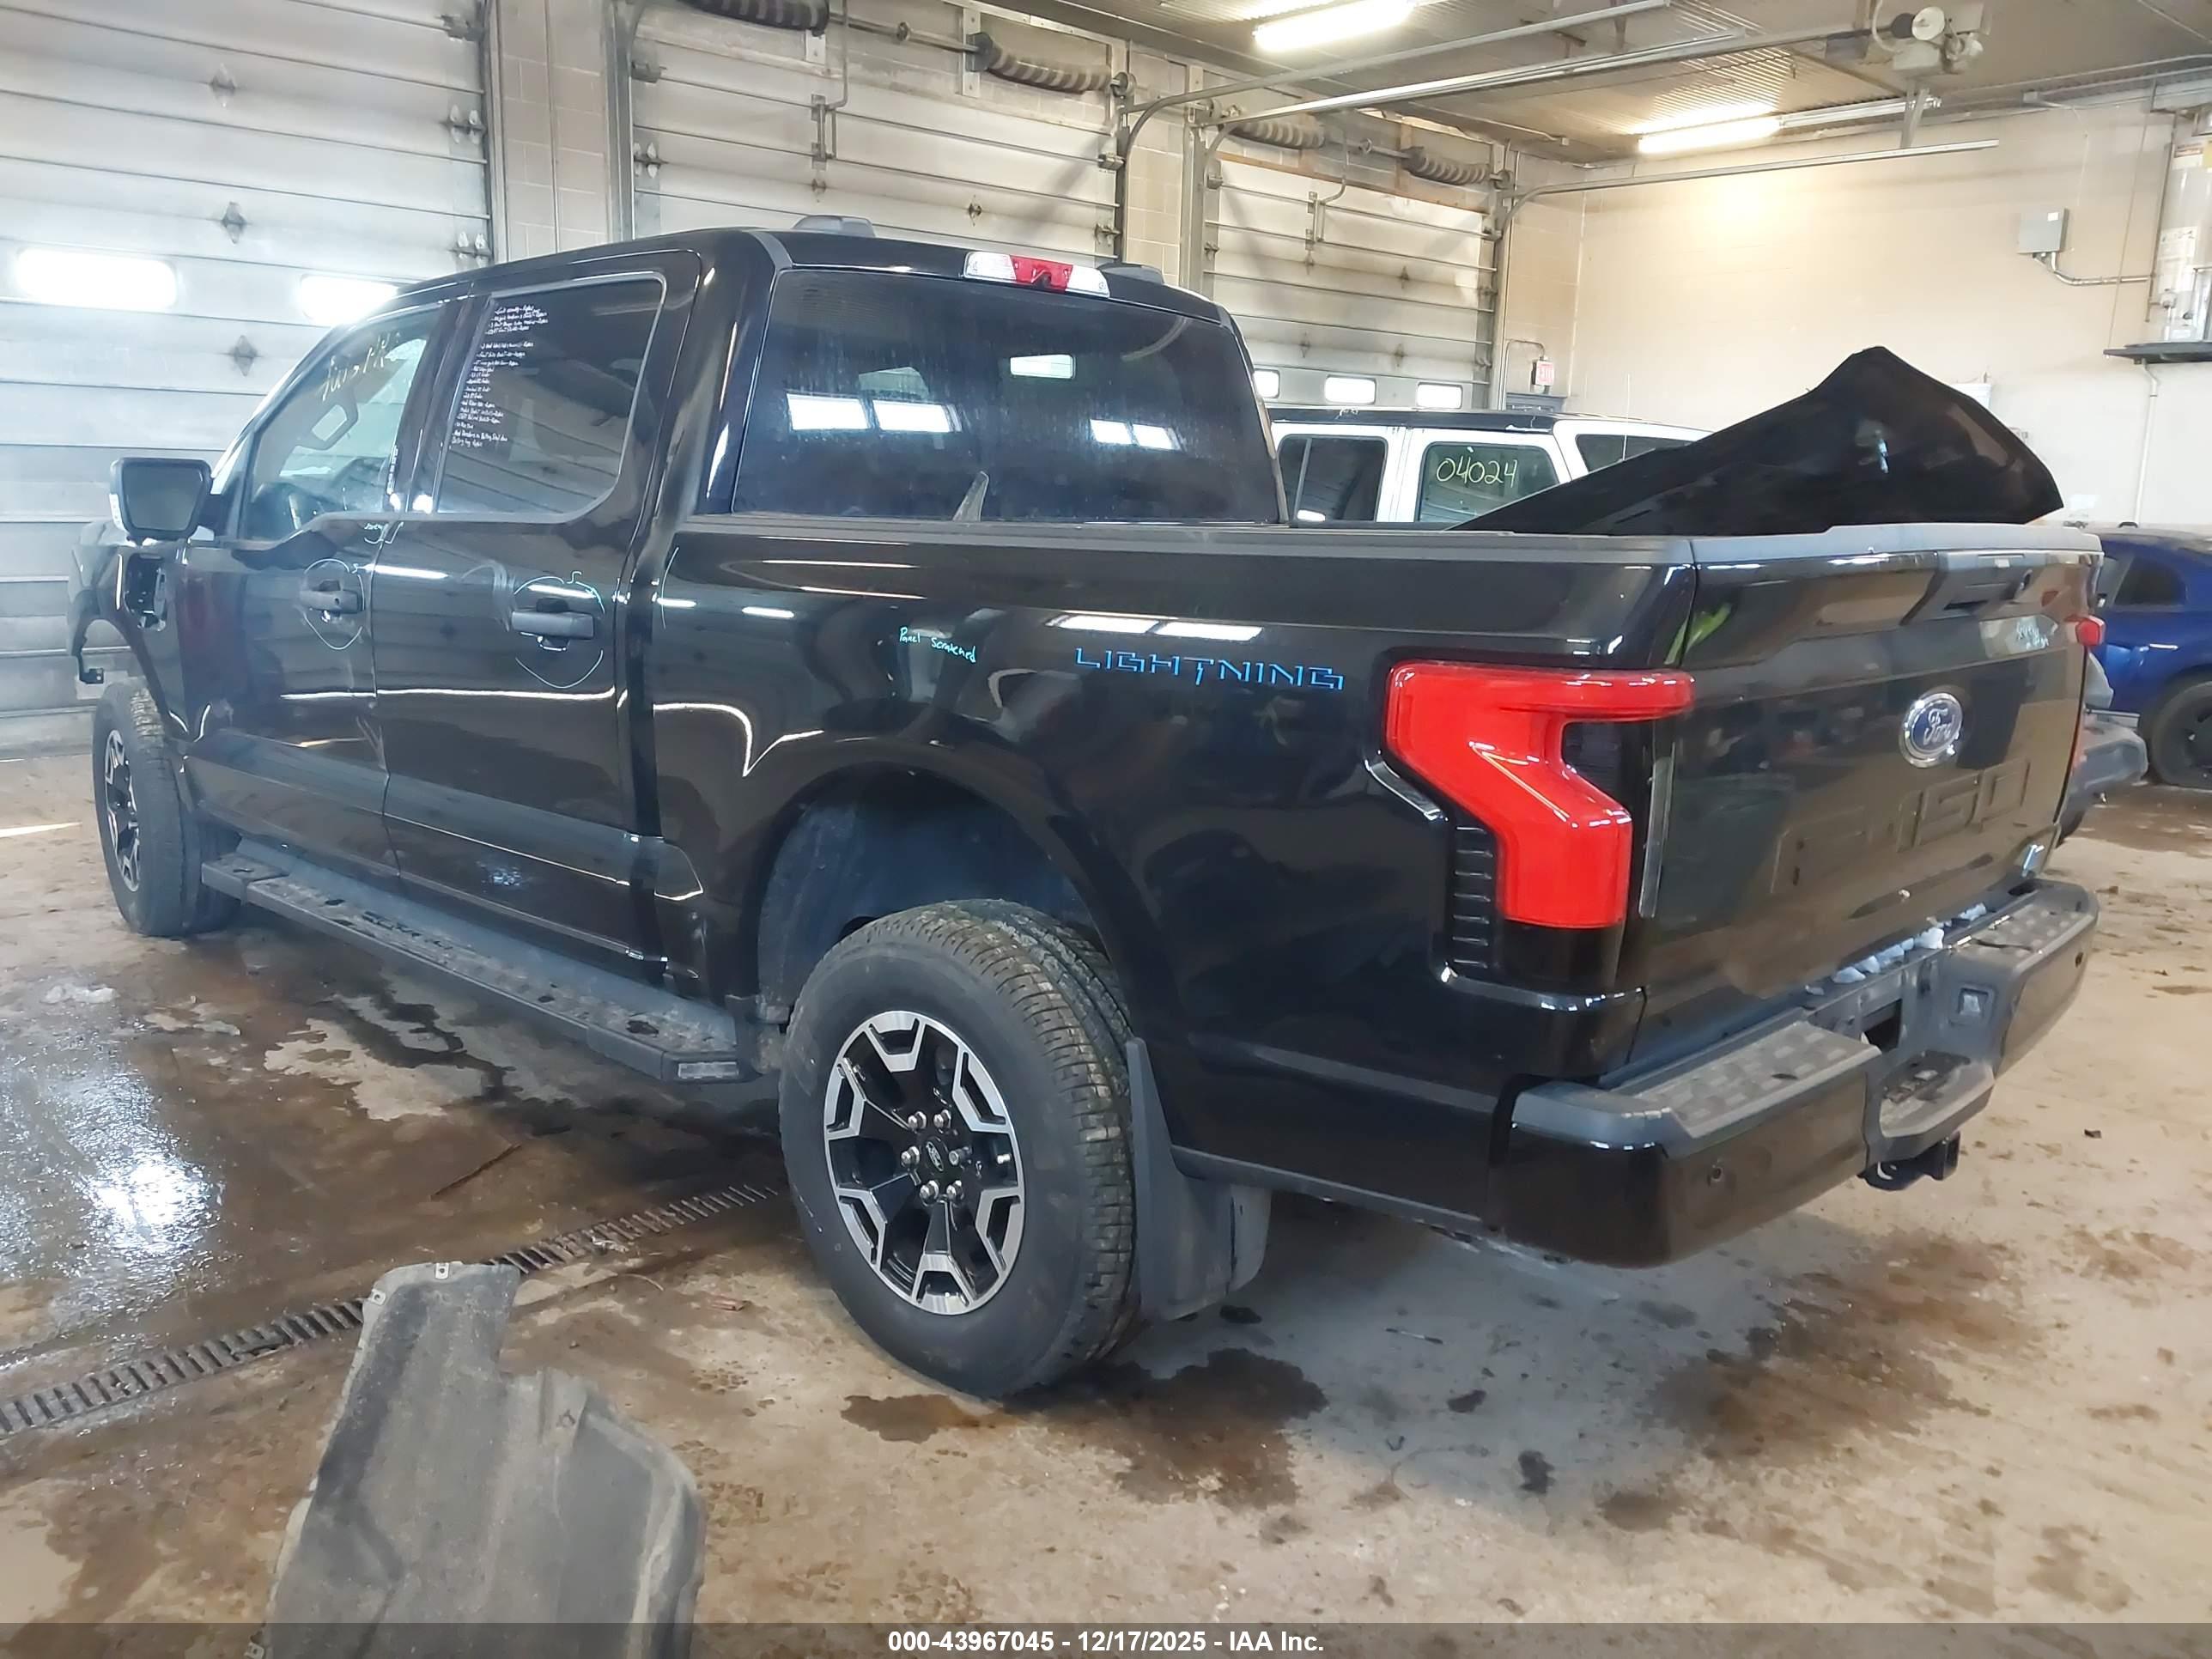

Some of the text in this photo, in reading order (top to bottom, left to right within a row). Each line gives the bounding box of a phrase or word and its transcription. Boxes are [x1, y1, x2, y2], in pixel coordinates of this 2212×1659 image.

[1436, 455, 1518, 489] 04024
[899, 626, 921, 643] Panel
[1075, 647, 1345, 691] LIGHTNING
[1923, 708, 1956, 746] Ford
